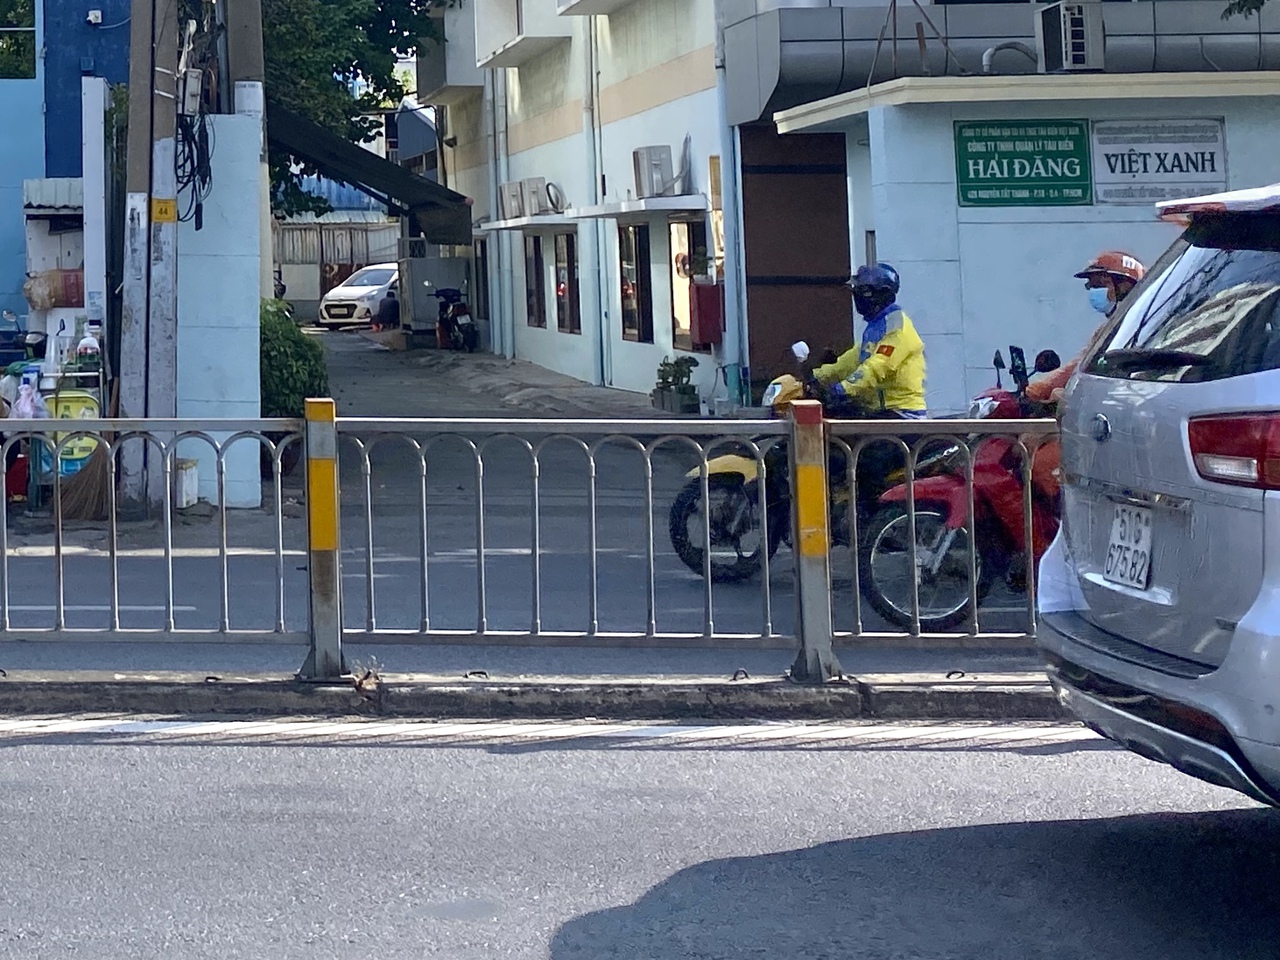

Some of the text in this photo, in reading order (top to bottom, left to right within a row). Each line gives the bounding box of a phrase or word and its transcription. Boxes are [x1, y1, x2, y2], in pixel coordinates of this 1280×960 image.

[967, 153, 1081, 179] HẢI ĐĂNG
[1103, 148, 1217, 179] VIỆT XANH
